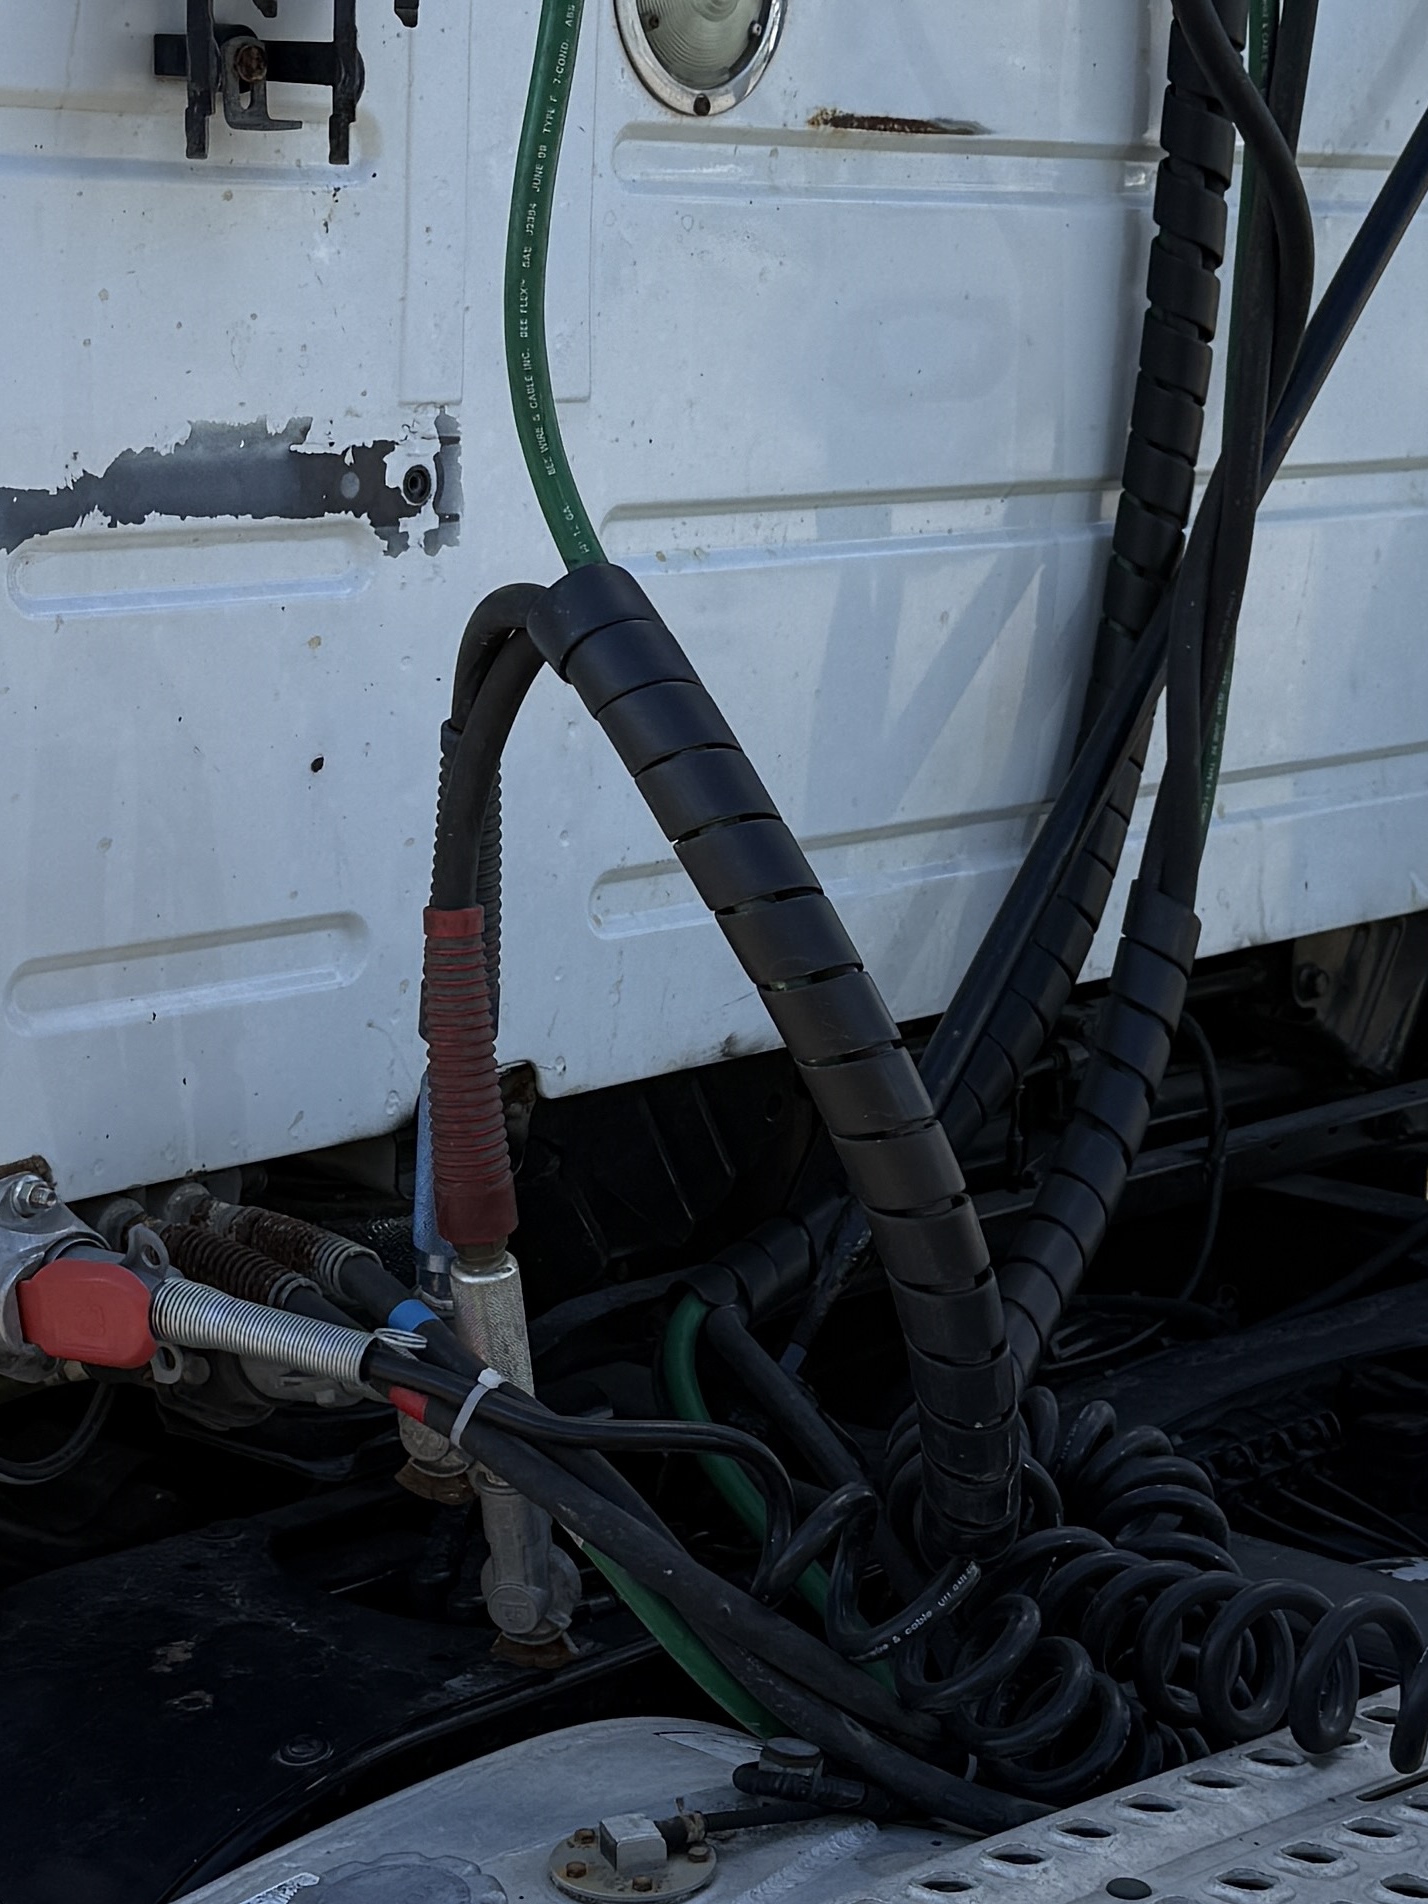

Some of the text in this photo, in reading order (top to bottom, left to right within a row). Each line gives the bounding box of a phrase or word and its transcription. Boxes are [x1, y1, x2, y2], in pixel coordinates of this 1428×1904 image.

[531, 163, 544, 192] JUNE
[535, 426, 549, 453] WIRE
[904, 1610, 933, 1635] cable
